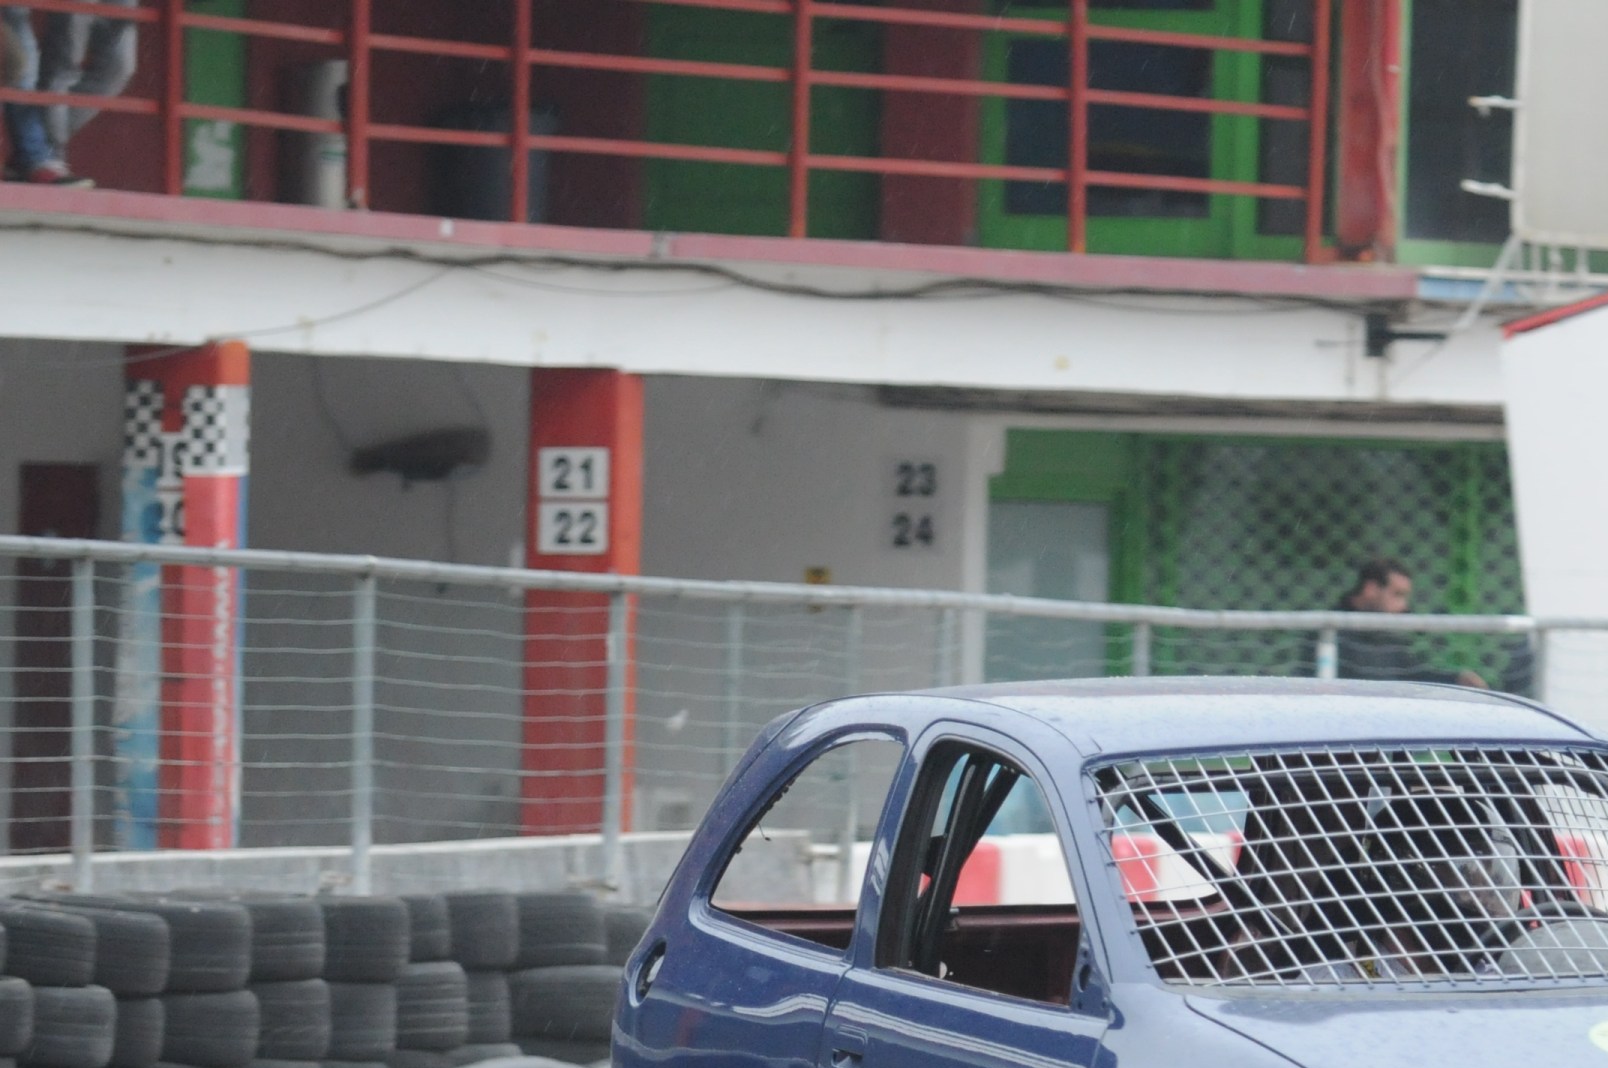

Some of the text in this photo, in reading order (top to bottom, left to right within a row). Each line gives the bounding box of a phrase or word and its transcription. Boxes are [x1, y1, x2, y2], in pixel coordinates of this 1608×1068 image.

[552, 457, 595, 490] 21
[897, 462, 937, 497] 23
[554, 511, 597, 544] 22
[893, 513, 935, 547] 24
